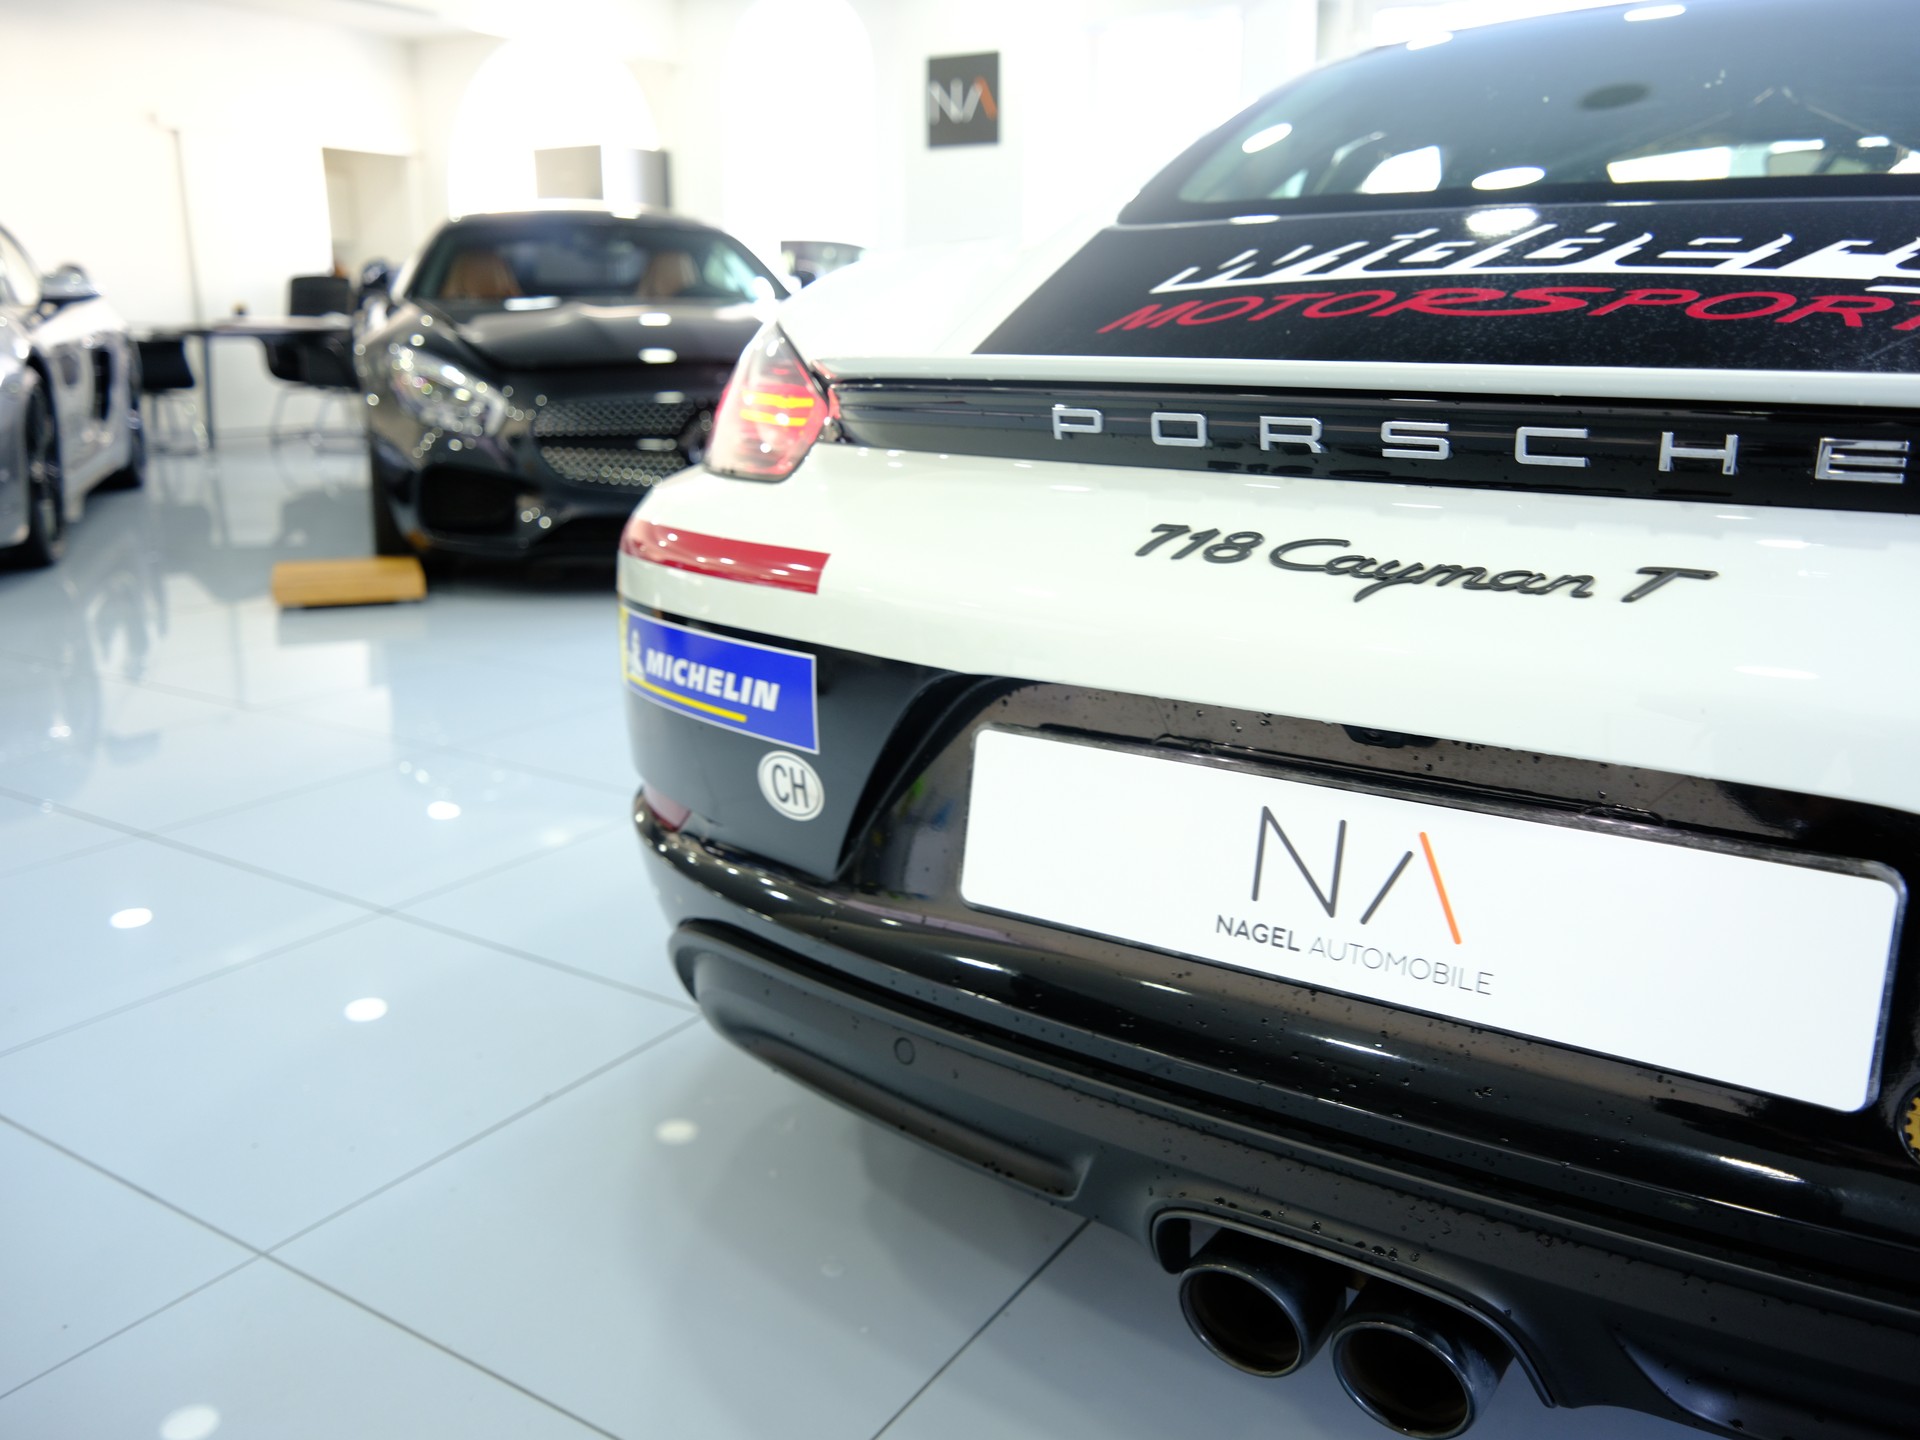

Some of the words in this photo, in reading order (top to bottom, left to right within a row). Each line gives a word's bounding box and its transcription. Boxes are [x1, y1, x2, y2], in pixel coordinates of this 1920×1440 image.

[1052, 404, 1909, 484] PORSCHE
[1135, 523, 1265, 563] 718
[1269, 538, 1594, 603] Cayman
[1621, 566, 1718, 602] T
[646, 648, 780, 711] MICHELIN
[772, 764, 809, 808] CH
[1251, 805, 1462, 945] NA
[1216, 914, 1300, 952] NAGEL
[1308, 937, 1495, 996] AUTOMOBILE
